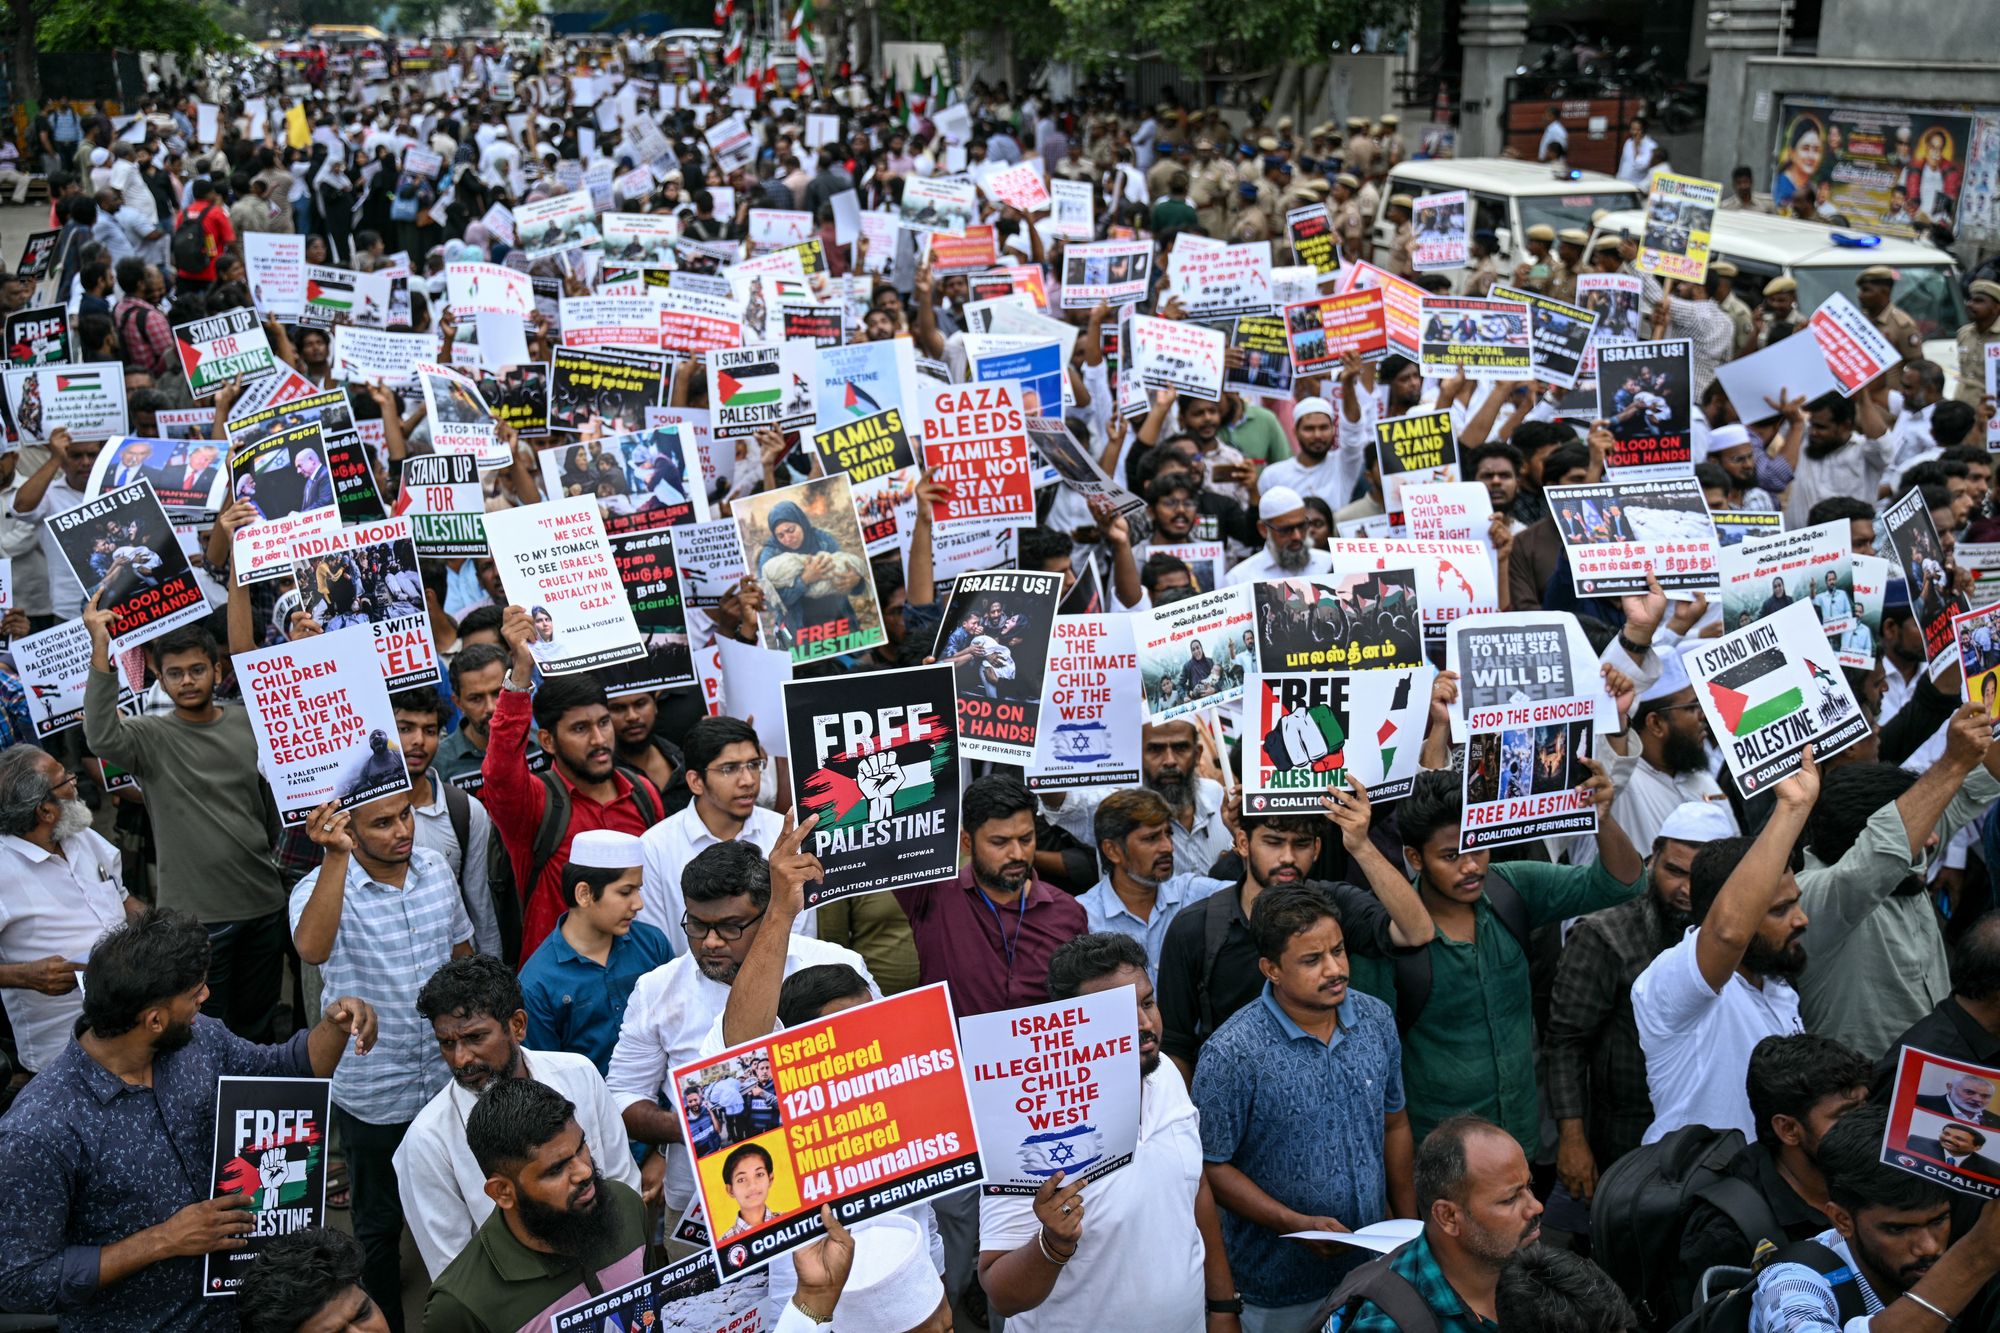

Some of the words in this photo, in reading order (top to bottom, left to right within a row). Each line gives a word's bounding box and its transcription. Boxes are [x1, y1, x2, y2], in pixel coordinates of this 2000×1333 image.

[31, 236, 56, 250] FREE
[313, 268, 336, 279] STAND
[339, 272, 357, 282] WITH
[1423, 299, 1457, 308] TAMILS
[1458, 300, 1483, 310] STAND
[1489, 304, 1526, 312] AGAINST
[15, 317, 62, 344] FREE
[189, 318, 229, 344] STAND
[231, 311, 251, 333] UP
[212, 337, 239, 358] FOR
[715, 353, 718, 366] I
[723, 351, 754, 365] STAND
[757, 348, 779, 361] WITH
[1448, 345, 1505, 355] GENOCIDAL
[1603, 346, 1657, 362] ISRAEL!
[1661, 344, 1684, 357] US!
[200, 350, 271, 384] PALESTINE
[830, 356, 868, 366] TALKING
[835, 366, 865, 374] ABOUT
[1478, 355, 1529, 366] ALLIANCE!
[825, 372, 879, 387] PALESTINE
[935, 387, 1012, 414] GAZA
[720, 403, 782, 424] PALESTINE
[924, 410, 1022, 439] BLEEDS
[443, 425, 468, 434] STOP
[473, 425, 490, 434] THE
[816, 411, 902, 456] TAMILS
[1378, 414, 1450, 443] TAMILS
[839, 438, 895, 467] STAND
[940, 439, 1013, 463] TAMILS
[1394, 435, 1444, 457] STAND
[410, 457, 448, 485] STAND
[453, 455, 472, 482] UP
[849, 456, 895, 484] WITH
[928, 464, 979, 482] WILL
[987, 457, 1027, 477] NOT
[1401, 453, 1441, 471] WITH
[955, 478, 1005, 496] STAY
[1551, 488, 1614, 499] கொலைகார
[1619, 480, 1697, 494] அமெரிக்காவே!
[56, 495, 117, 532] ISRAEL!
[120, 484, 145, 505] US!
[426, 487, 454, 512] FOR
[949, 495, 1024, 517] SILENT!
[1411, 505, 1466, 518] CHILDREN
[554, 531, 569, 542] ME
[572, 526, 593, 538] SICK
[679, 530, 696, 539] THE
[698, 524, 735, 535] VICTORY
[1413, 518, 1442, 529] HAVE
[292, 534, 349, 559] INDIA!
[355, 522, 407, 545] MODI!
[691, 532, 737, 545] CONTINUE
[1337, 543, 1379, 552] FREE
[1385, 543, 1481, 554] PALESTINE!
[514, 553, 529, 564] TO
[533, 549, 550, 560] MY
[552, 540, 599, 557] STOMACH
[1579, 544, 1645, 558] பாலஸ்தீன
[1656, 543, 1709, 554] மக்களை
[521, 566, 536, 577] TO
[539, 563, 557, 574] SEE
[560, 554, 604, 569] ISRAEL'S
[539, 572, 585, 589] CRUELTY
[588, 568, 608, 579] AND
[959, 576, 1016, 593] ISRAEL!
[1023, 578, 1052, 595] US!
[113, 590, 160, 617] BLOOD
[163, 579, 185, 596] ON
[545, 585, 598, 602] BRUTALITY
[602, 582, 612, 591] IN
[385, 615, 425, 633] WITH
[797, 618, 850, 645] FREE
[1065, 640, 1095, 653] THE
[1470, 635, 1500, 644] FROM
[1502, 634, 1524, 643] THE
[1526, 631, 1559, 641] RIVER
[1470, 644, 1492, 657] TO
[1495, 643, 1525, 655] THE
[1530, 641, 1561, 652] SEA
[1286, 640, 1396, 666] பாலஸ்தீனம்
[1471, 653, 1562, 669] PALESTINE
[1696, 657, 1705, 677] I
[1708, 638, 1744, 673] STAND
[1745, 623, 1779, 652] WITH
[58, 670, 70, 680] OF
[252, 660, 337, 691] CHILDREN
[389, 670, 436, 687] PERIYARISTS
[1058, 673, 1106, 688] CHILD
[1472, 668, 1531, 687] WILL
[1537, 666, 1564, 682] BE
[256, 685, 302, 707] HAVE
[260, 704, 293, 721] THE
[298, 688, 347, 713] RIGHT
[1053, 691, 1074, 704] OF
[1082, 688, 1111, 702] THE
[264, 721, 288, 736] TO
[293, 711, 330, 730] LIVE
[335, 703, 353, 719] IN
[1060, 705, 1104, 720] WEST
[1472, 712, 1503, 729] STOP
[1507, 709, 1529, 724] THE
[1533, 700, 1594, 721] GENOCIDE!
[269, 727, 323, 751] PEACE
[331, 716, 363, 736] AND
[813, 702, 933, 769] FREE
[971, 720, 1035, 742] HANDS!
[1733, 708, 1818, 769] PALESTINE
[288, 776, 315, 786] FATHER
[815, 809, 946, 858] PALESTINE
[1477, 826, 1522, 842] COALITION
[1524, 824, 1535, 834] OF
[1536, 817, 1592, 833] PERIYARISTS
[821, 880, 873, 898] COALITION
[875, 877, 888, 885] OF
[891, 866, 954, 883] PERIYARISTS
[1012, 1007, 1090, 1037] ISRAEL
[772, 1026, 836, 1067] Israel
[1030, 1030, 1074, 1053] THE
[778, 1040, 882, 1094] Murdered
[974, 1036, 1132, 1081] ILLEGITIMATE
[783, 1086, 824, 1119] 120
[828, 1048, 954, 1110] journalists
[1021, 1067, 1091, 1093] CHILD
[1015, 1097, 1047, 1113] OF
[1056, 1083, 1099, 1106] THE
[790, 1120, 822, 1148] Sri
[825, 1101, 887, 1138] Lanka
[1027, 1104, 1090, 1131] WEST
[235, 1110, 313, 1157] FREE
[796, 1120, 900, 1175] Murdered
[803, 1174, 832, 1200] 44
[836, 1131, 960, 1193] journalists
[560, 1283, 652, 1329] கொலைகார
